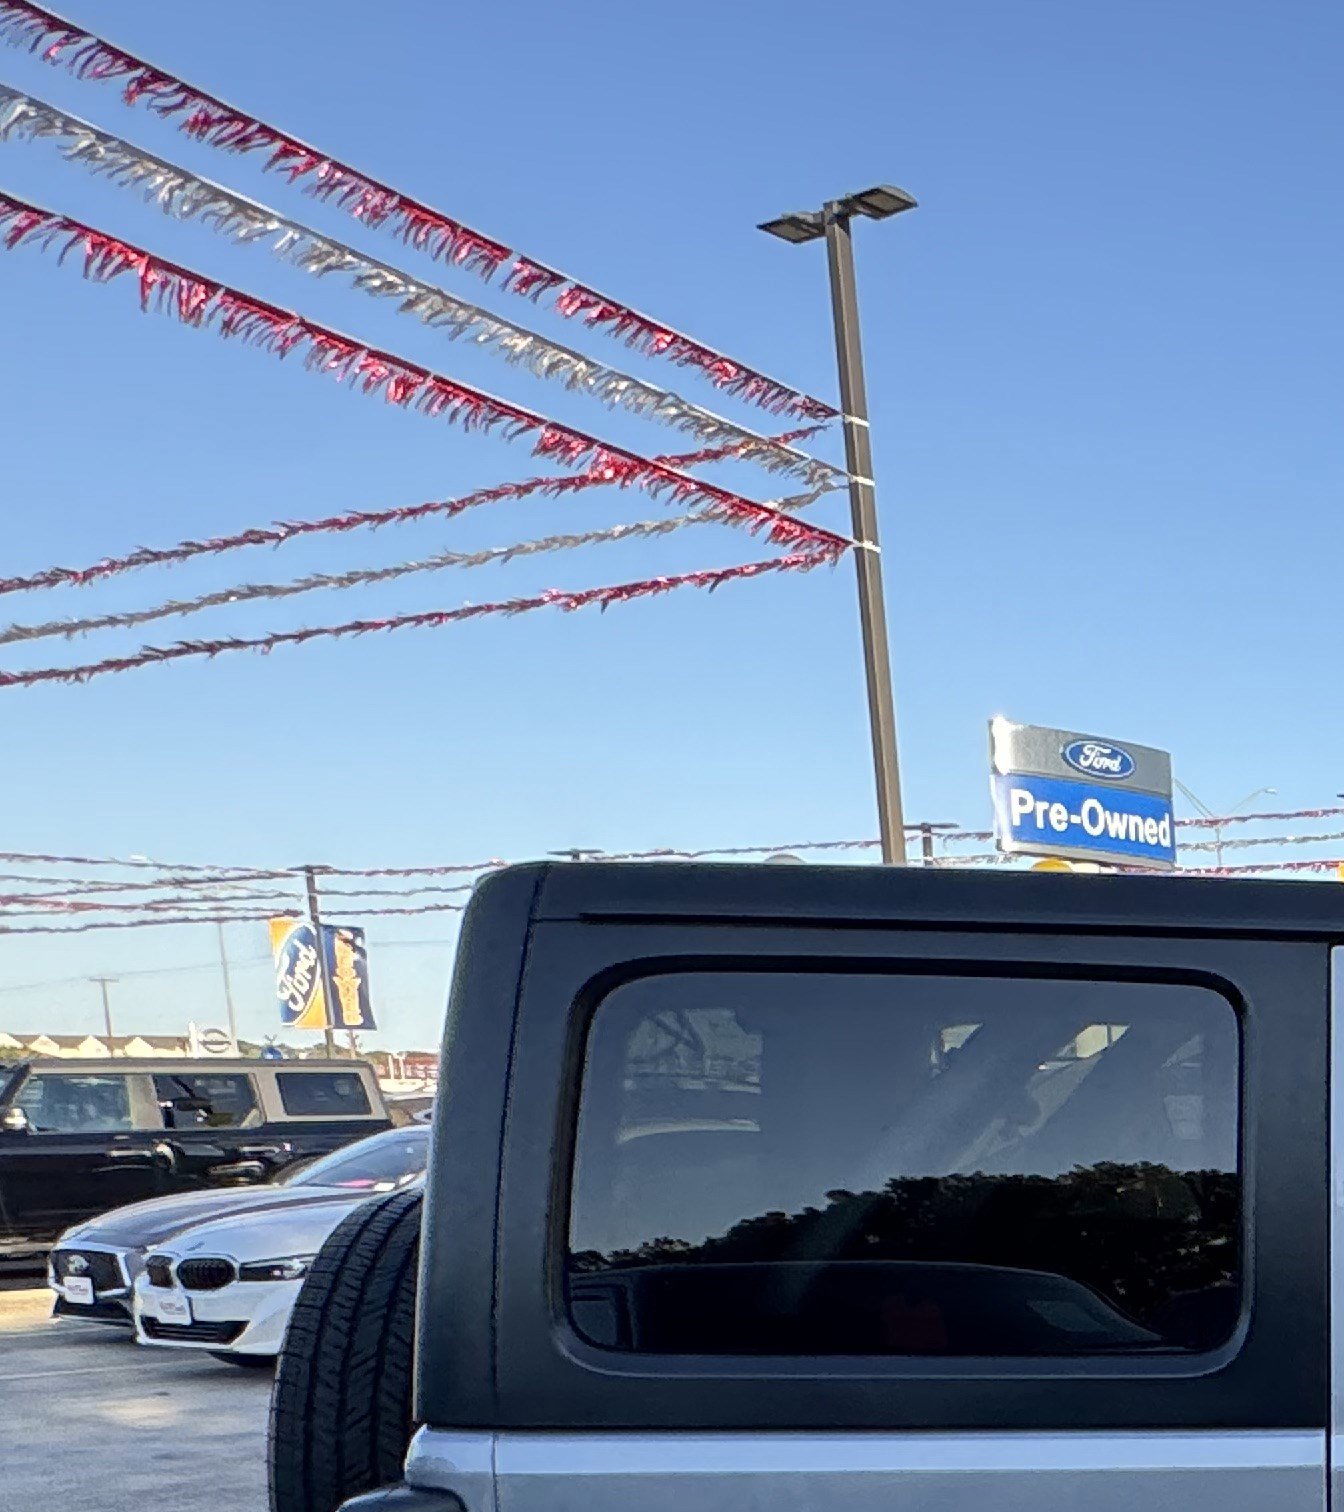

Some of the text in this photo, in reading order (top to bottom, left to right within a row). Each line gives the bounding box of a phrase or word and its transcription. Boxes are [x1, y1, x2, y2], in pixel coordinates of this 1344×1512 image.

[1079, 744, 1122, 773] Ford
[1009, 788, 1172, 848] Pre-Owned
[276, 939, 318, 1012] Ford
